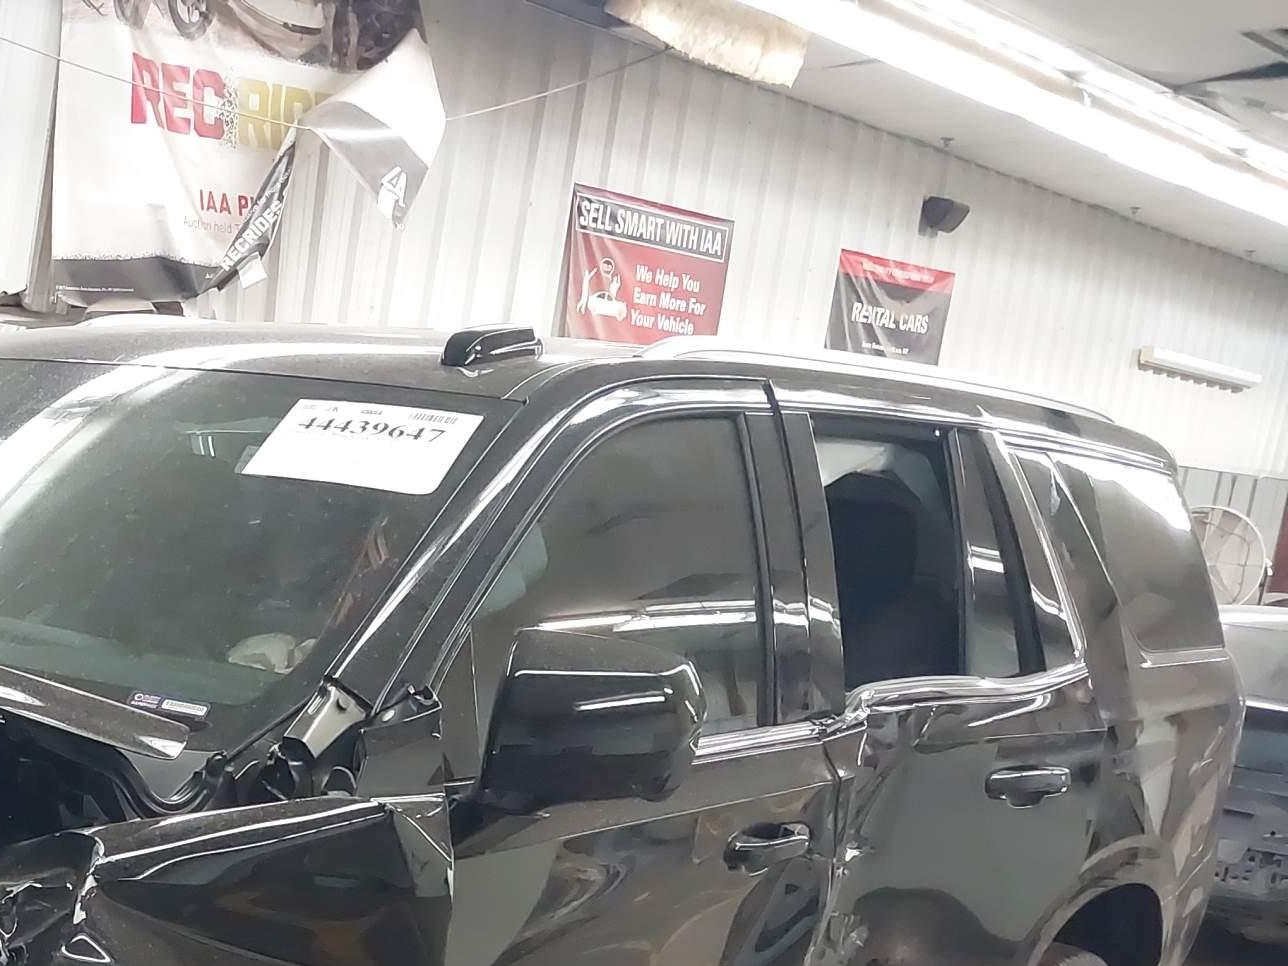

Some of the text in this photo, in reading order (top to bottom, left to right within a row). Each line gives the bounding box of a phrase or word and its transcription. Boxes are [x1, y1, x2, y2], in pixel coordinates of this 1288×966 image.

[200, 189, 232, 215] IAA
[238, 195, 255, 217] P
[219, 199, 283, 271] RECRIDES
[580, 199, 723, 256] SELL SMART WITH IAA
[636, 264, 700, 293] We Help You
[633, 287, 707, 316] Earn More For
[631, 308, 695, 336] Your Vehicle
[851, 301, 930, 336] RENTAL CARS
[298, 416, 447, 443] 44439647
